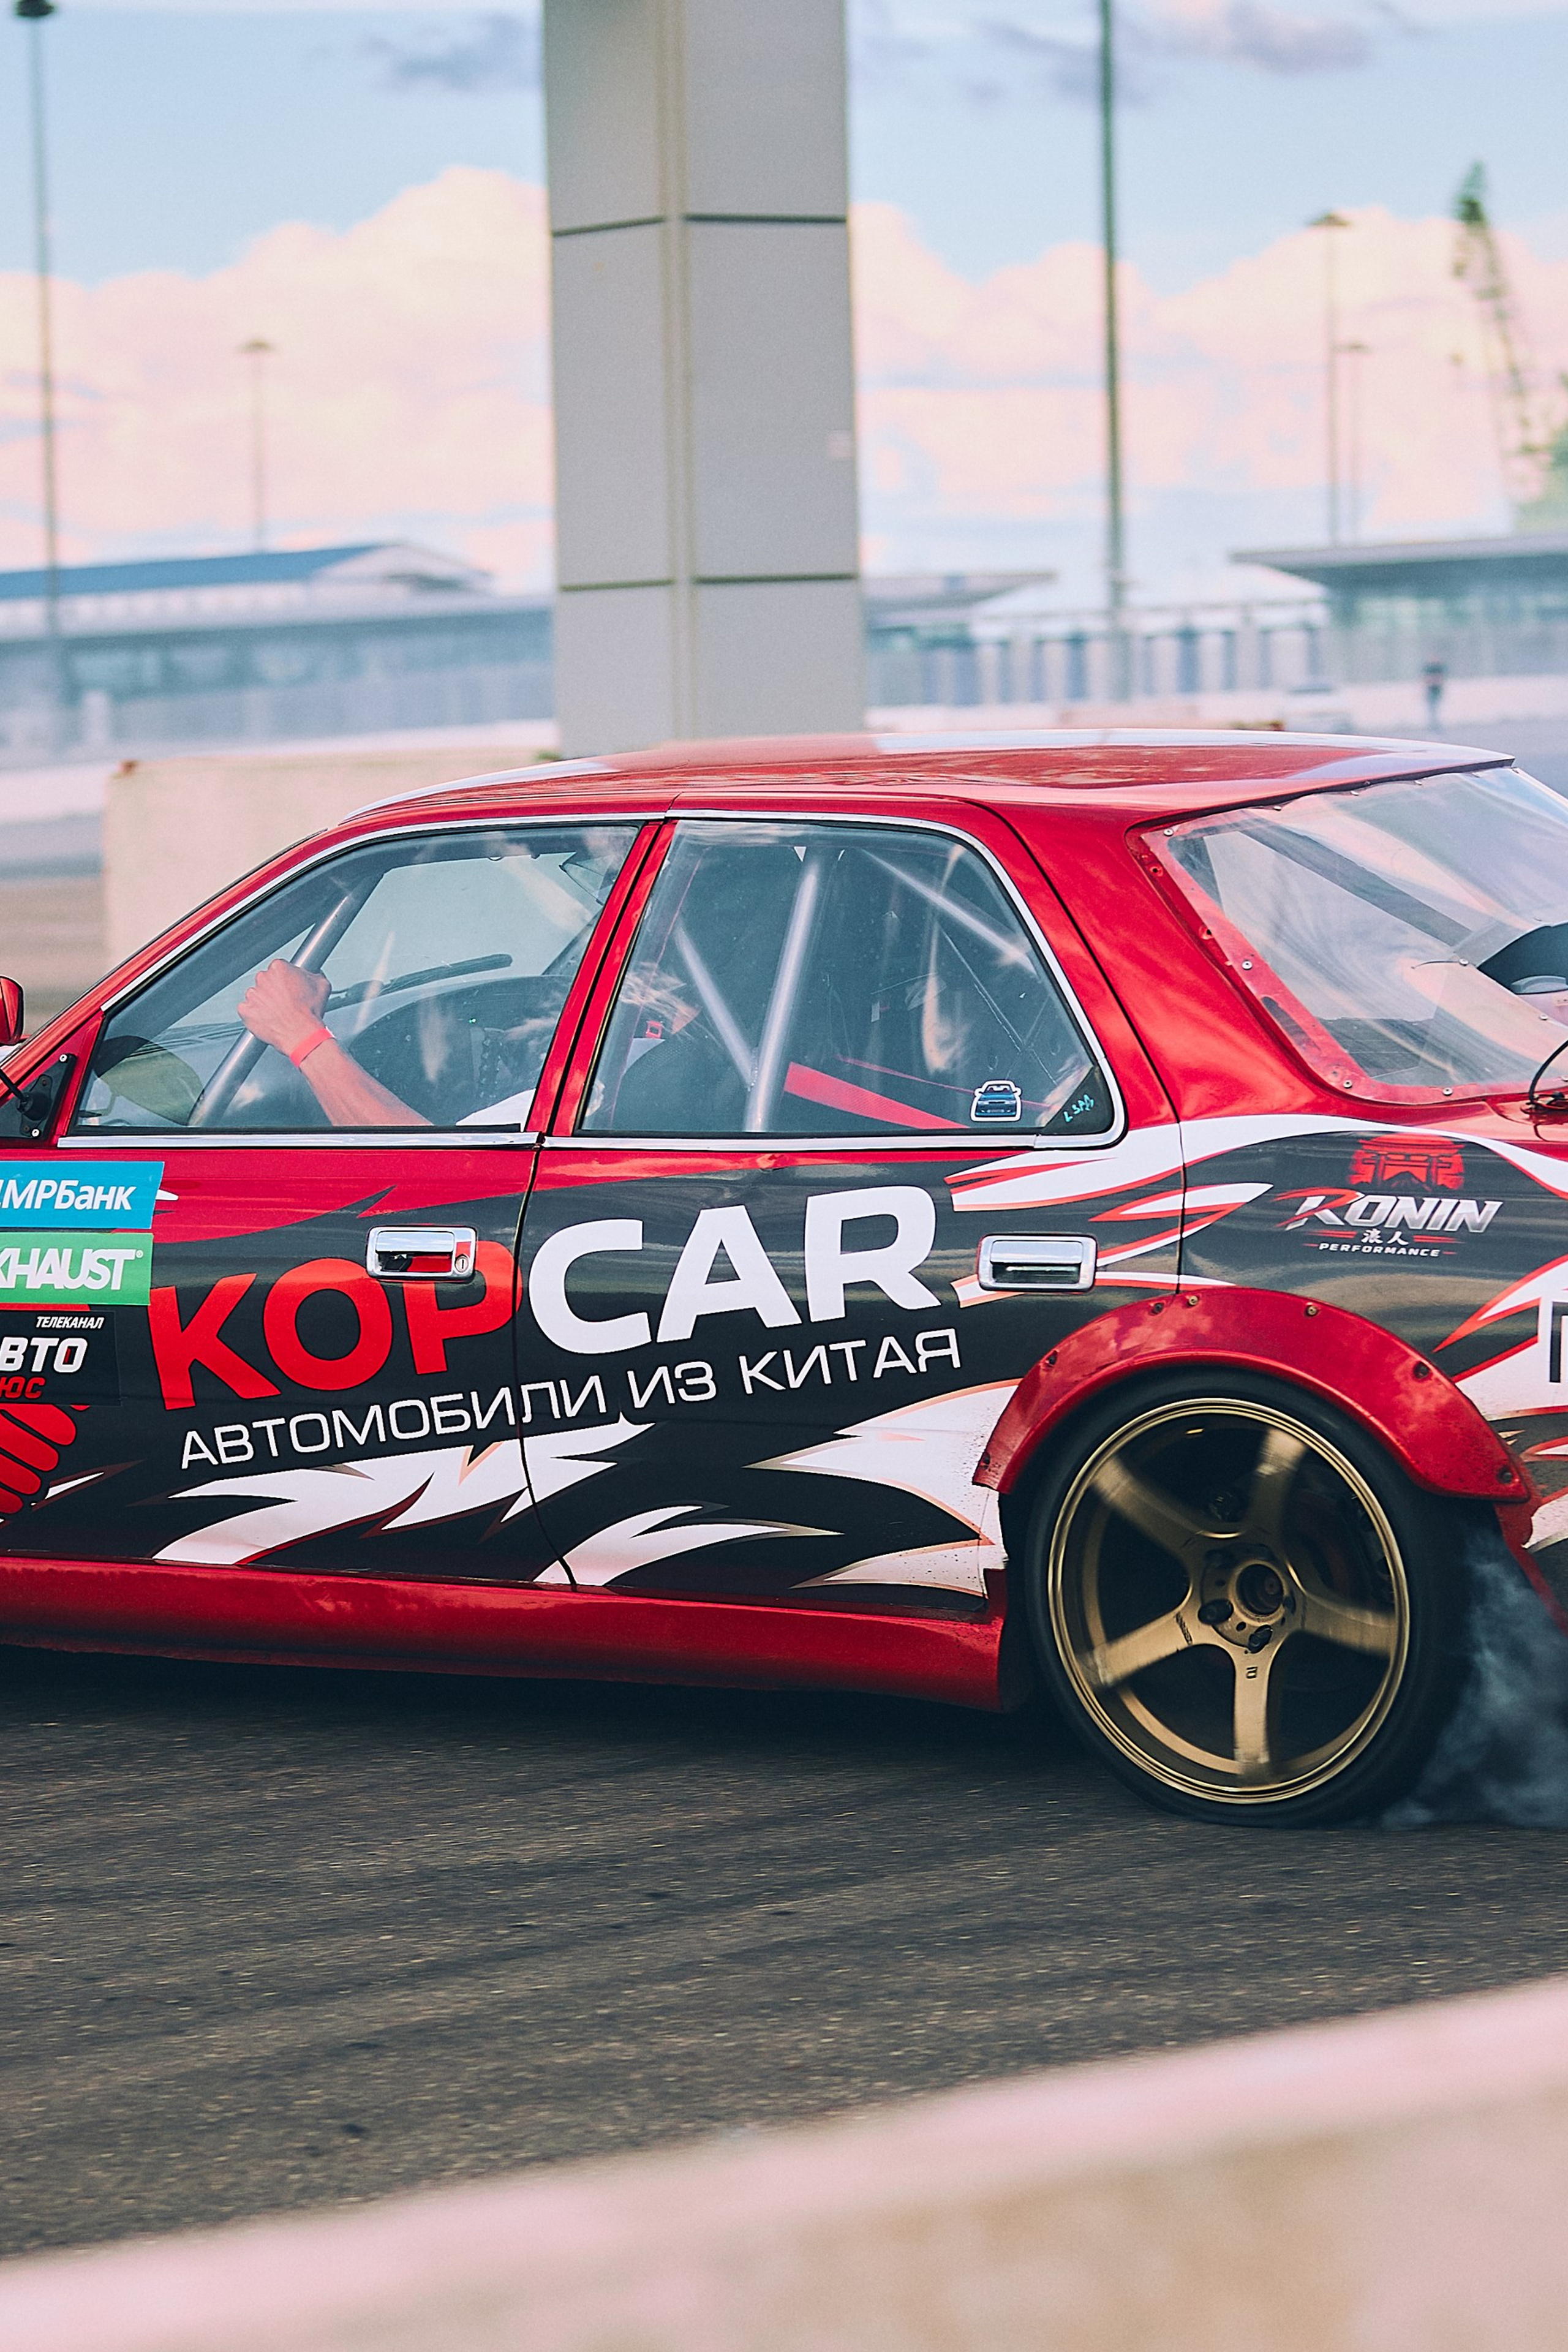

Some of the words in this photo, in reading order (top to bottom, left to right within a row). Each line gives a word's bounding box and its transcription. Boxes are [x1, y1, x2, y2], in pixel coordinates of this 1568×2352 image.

[0, 1180, 137, 1210] МРБанк
[1270, 1187, 1503, 1233] RONIN
[1319, 1243, 1441, 1257] PERFORMANCE
[36, 1316, 105, 1329] ТЕЛЕКАНАЛ
[181, 1375, 606, 1469] АВТОМОБИЛИ
[627, 1361, 717, 1408] ИЗ
[739, 1328, 960, 1395] КИТАЯ
